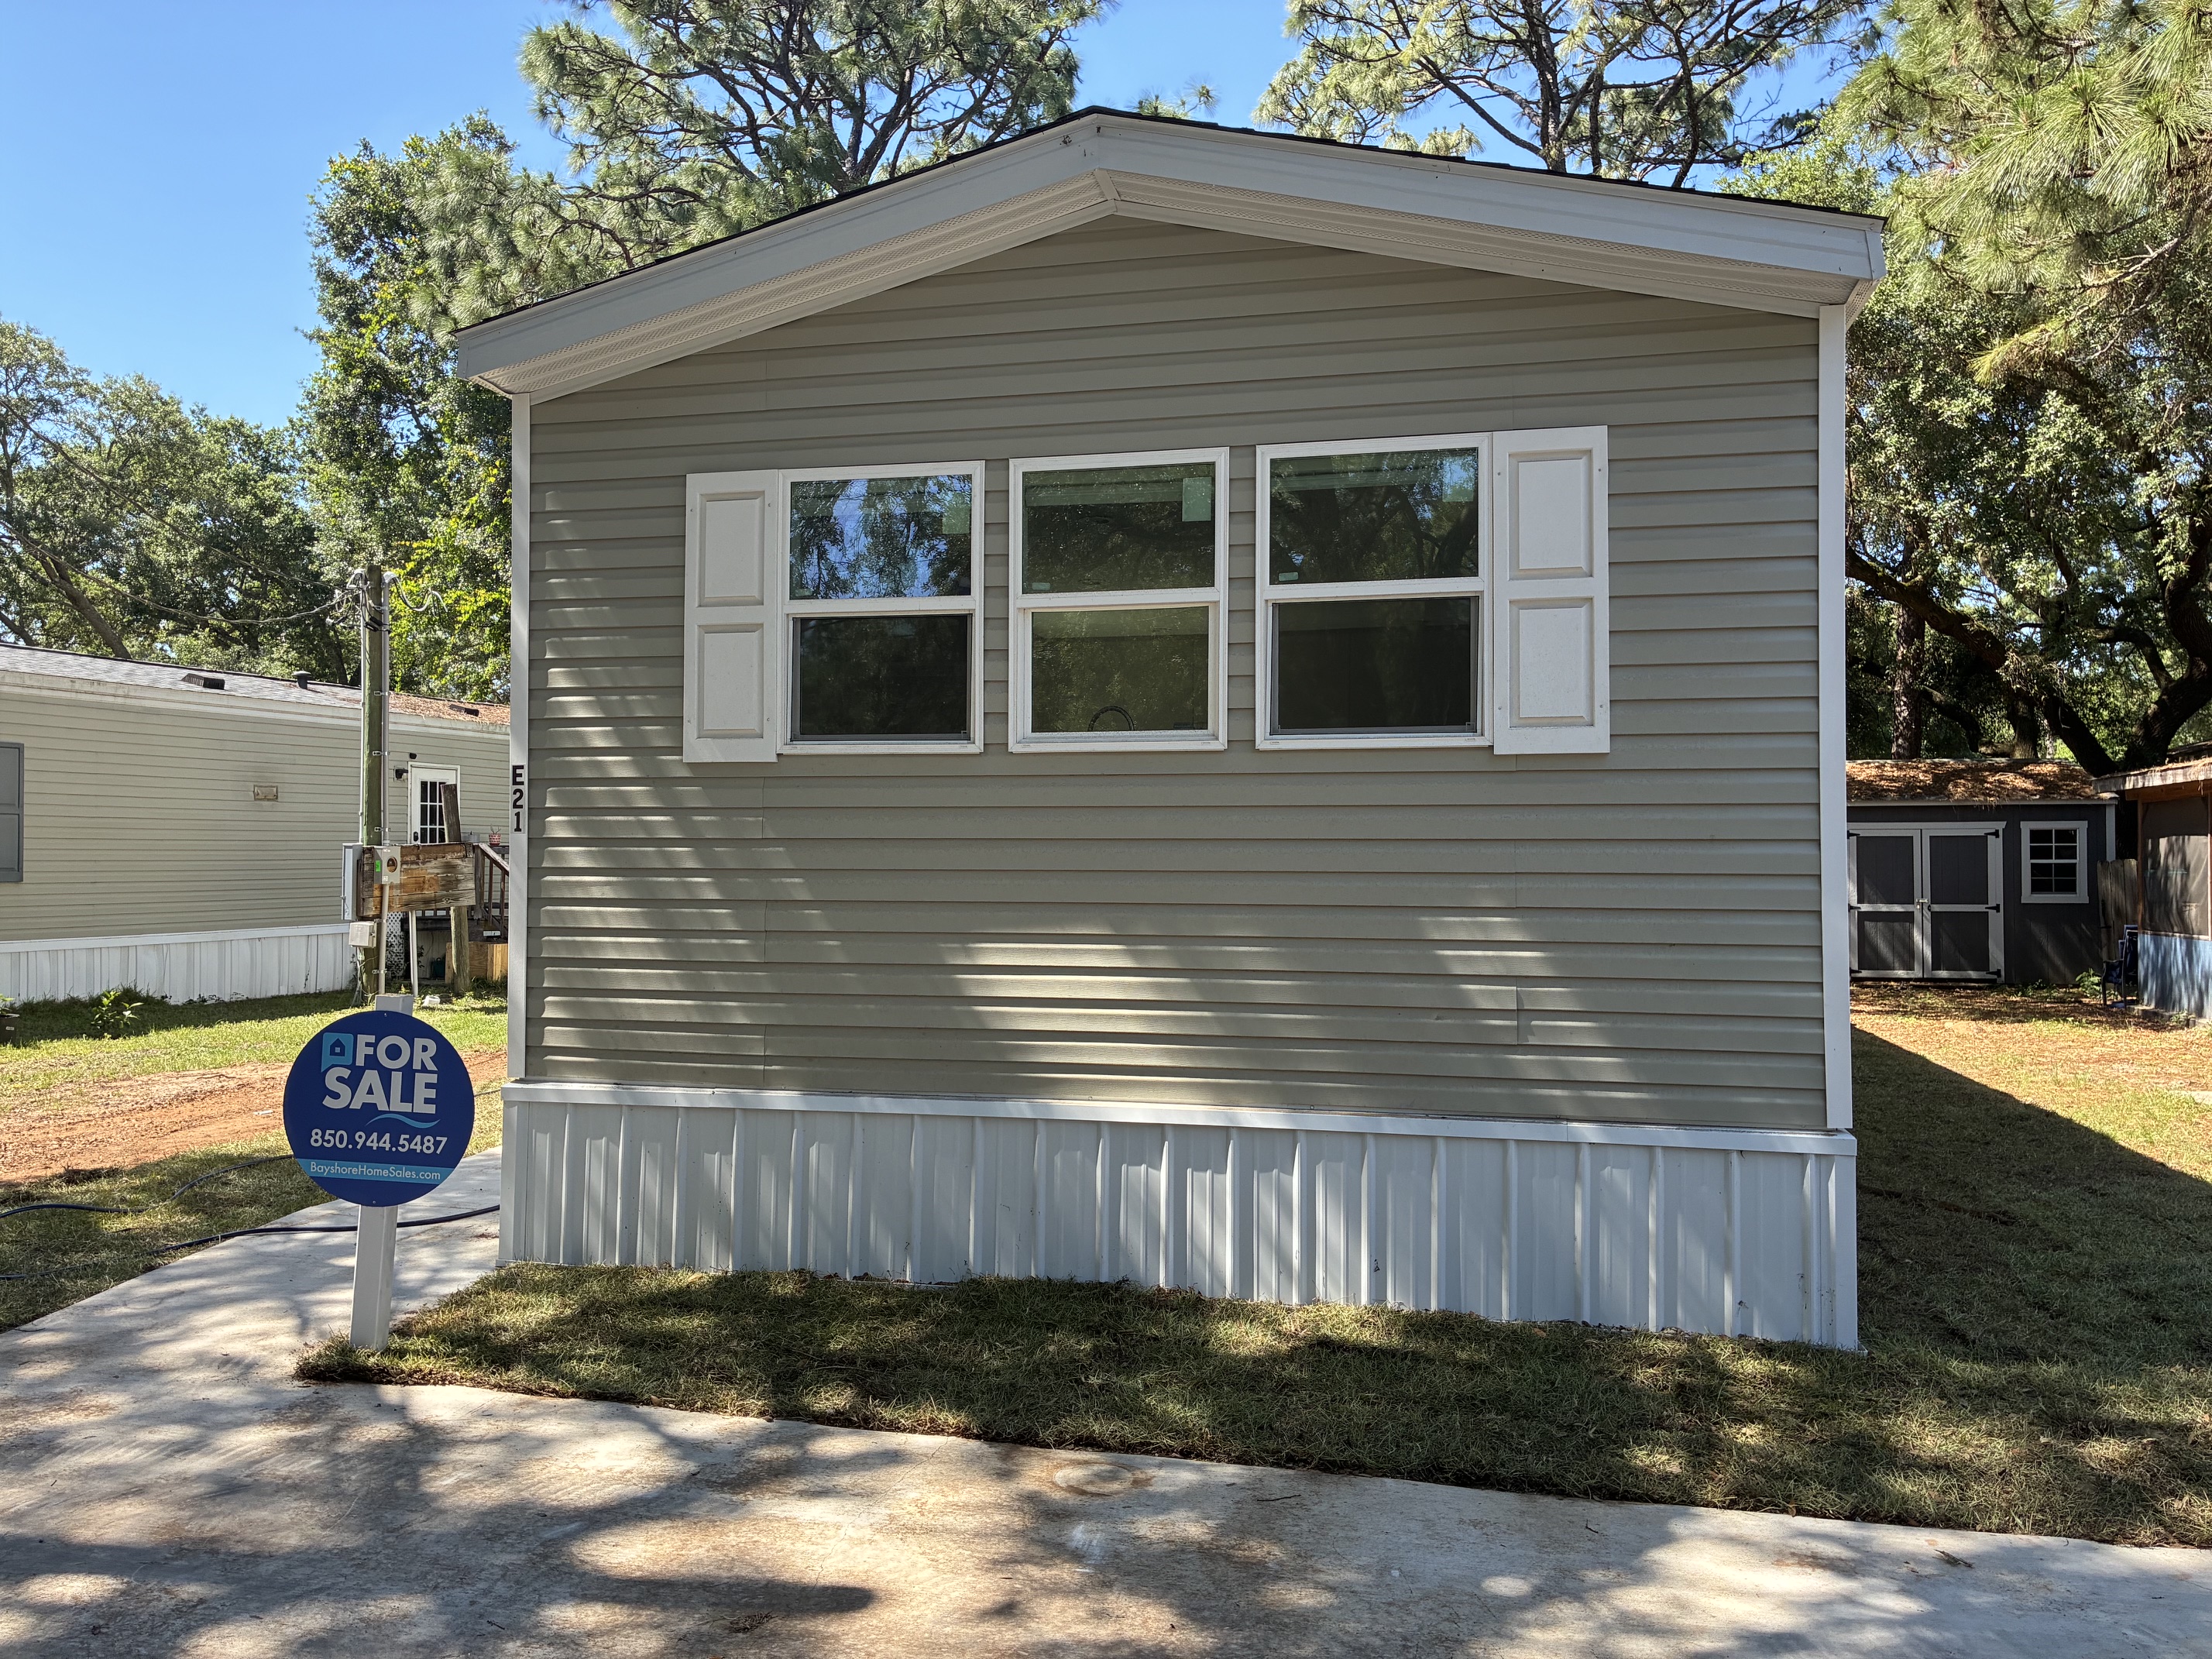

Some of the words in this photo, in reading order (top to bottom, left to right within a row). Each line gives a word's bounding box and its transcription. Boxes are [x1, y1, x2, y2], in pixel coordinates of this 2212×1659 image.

[512, 764, 524, 833] E21
[356, 1034, 438, 1071] FOR
[322, 1067, 438, 1115] SALE
[310, 1128, 448, 1155] 850.944.5487
[310, 1162, 441, 1180] BayshoreHomeSales.com
